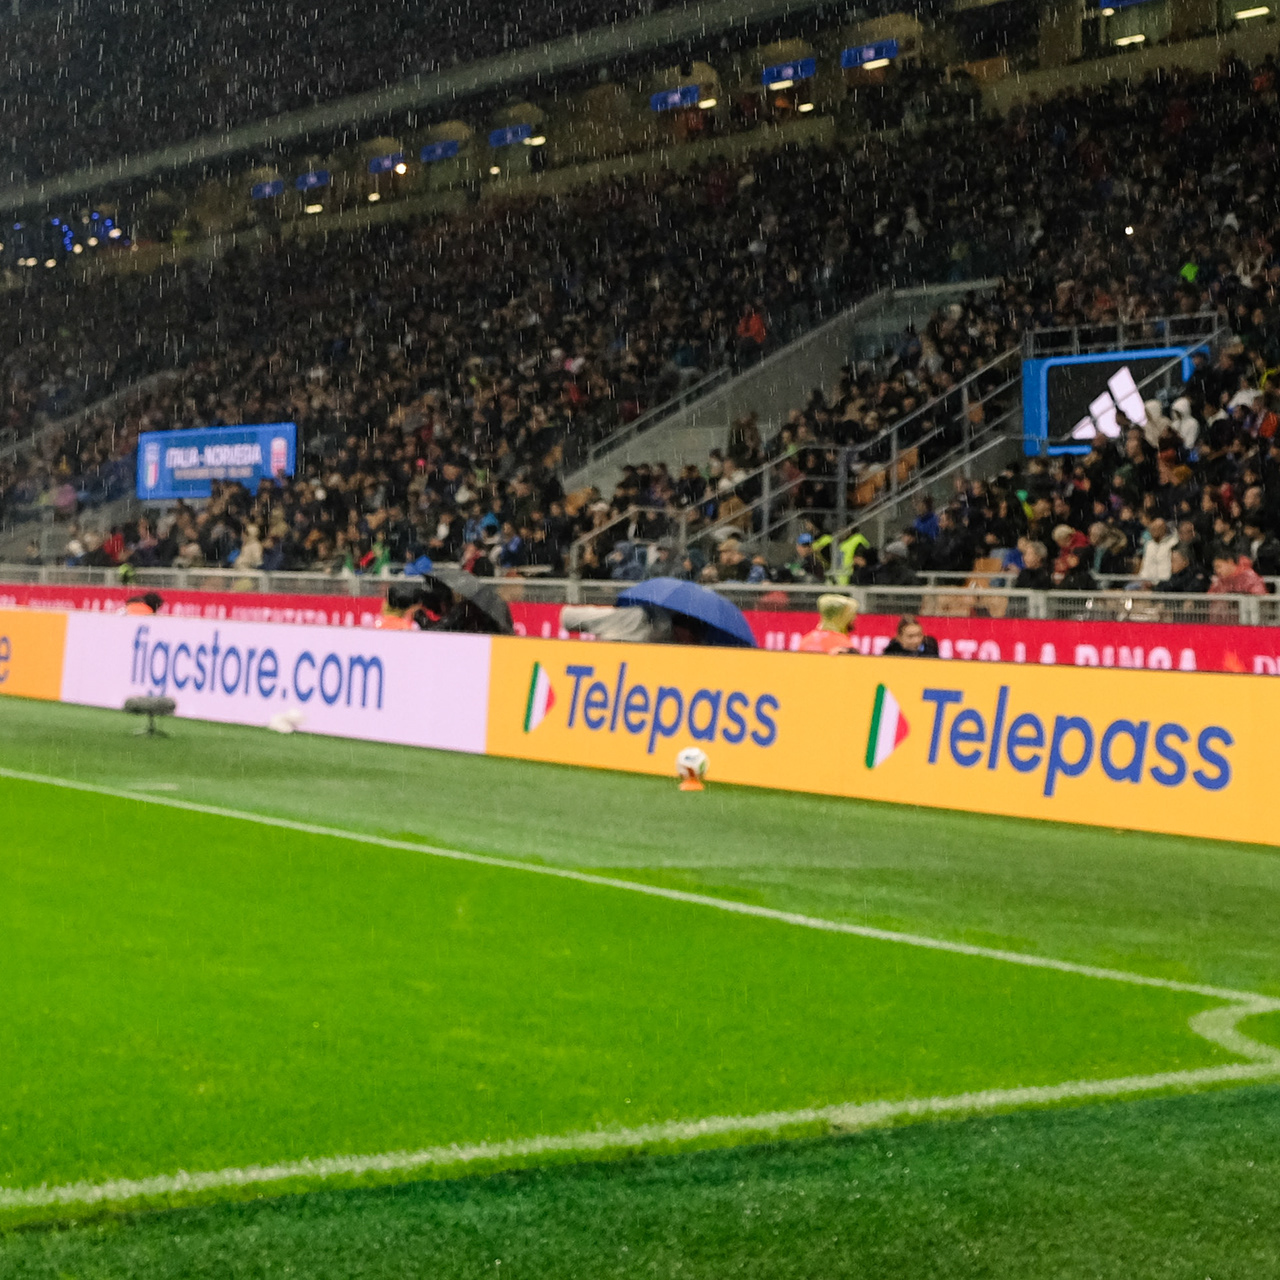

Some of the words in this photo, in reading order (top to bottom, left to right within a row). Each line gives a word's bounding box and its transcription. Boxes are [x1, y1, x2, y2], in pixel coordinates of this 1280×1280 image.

[133, 626, 384, 710] figcstore.com
[566, 663, 779, 753] Telepass
[923, 686, 1233, 797] Telepass
